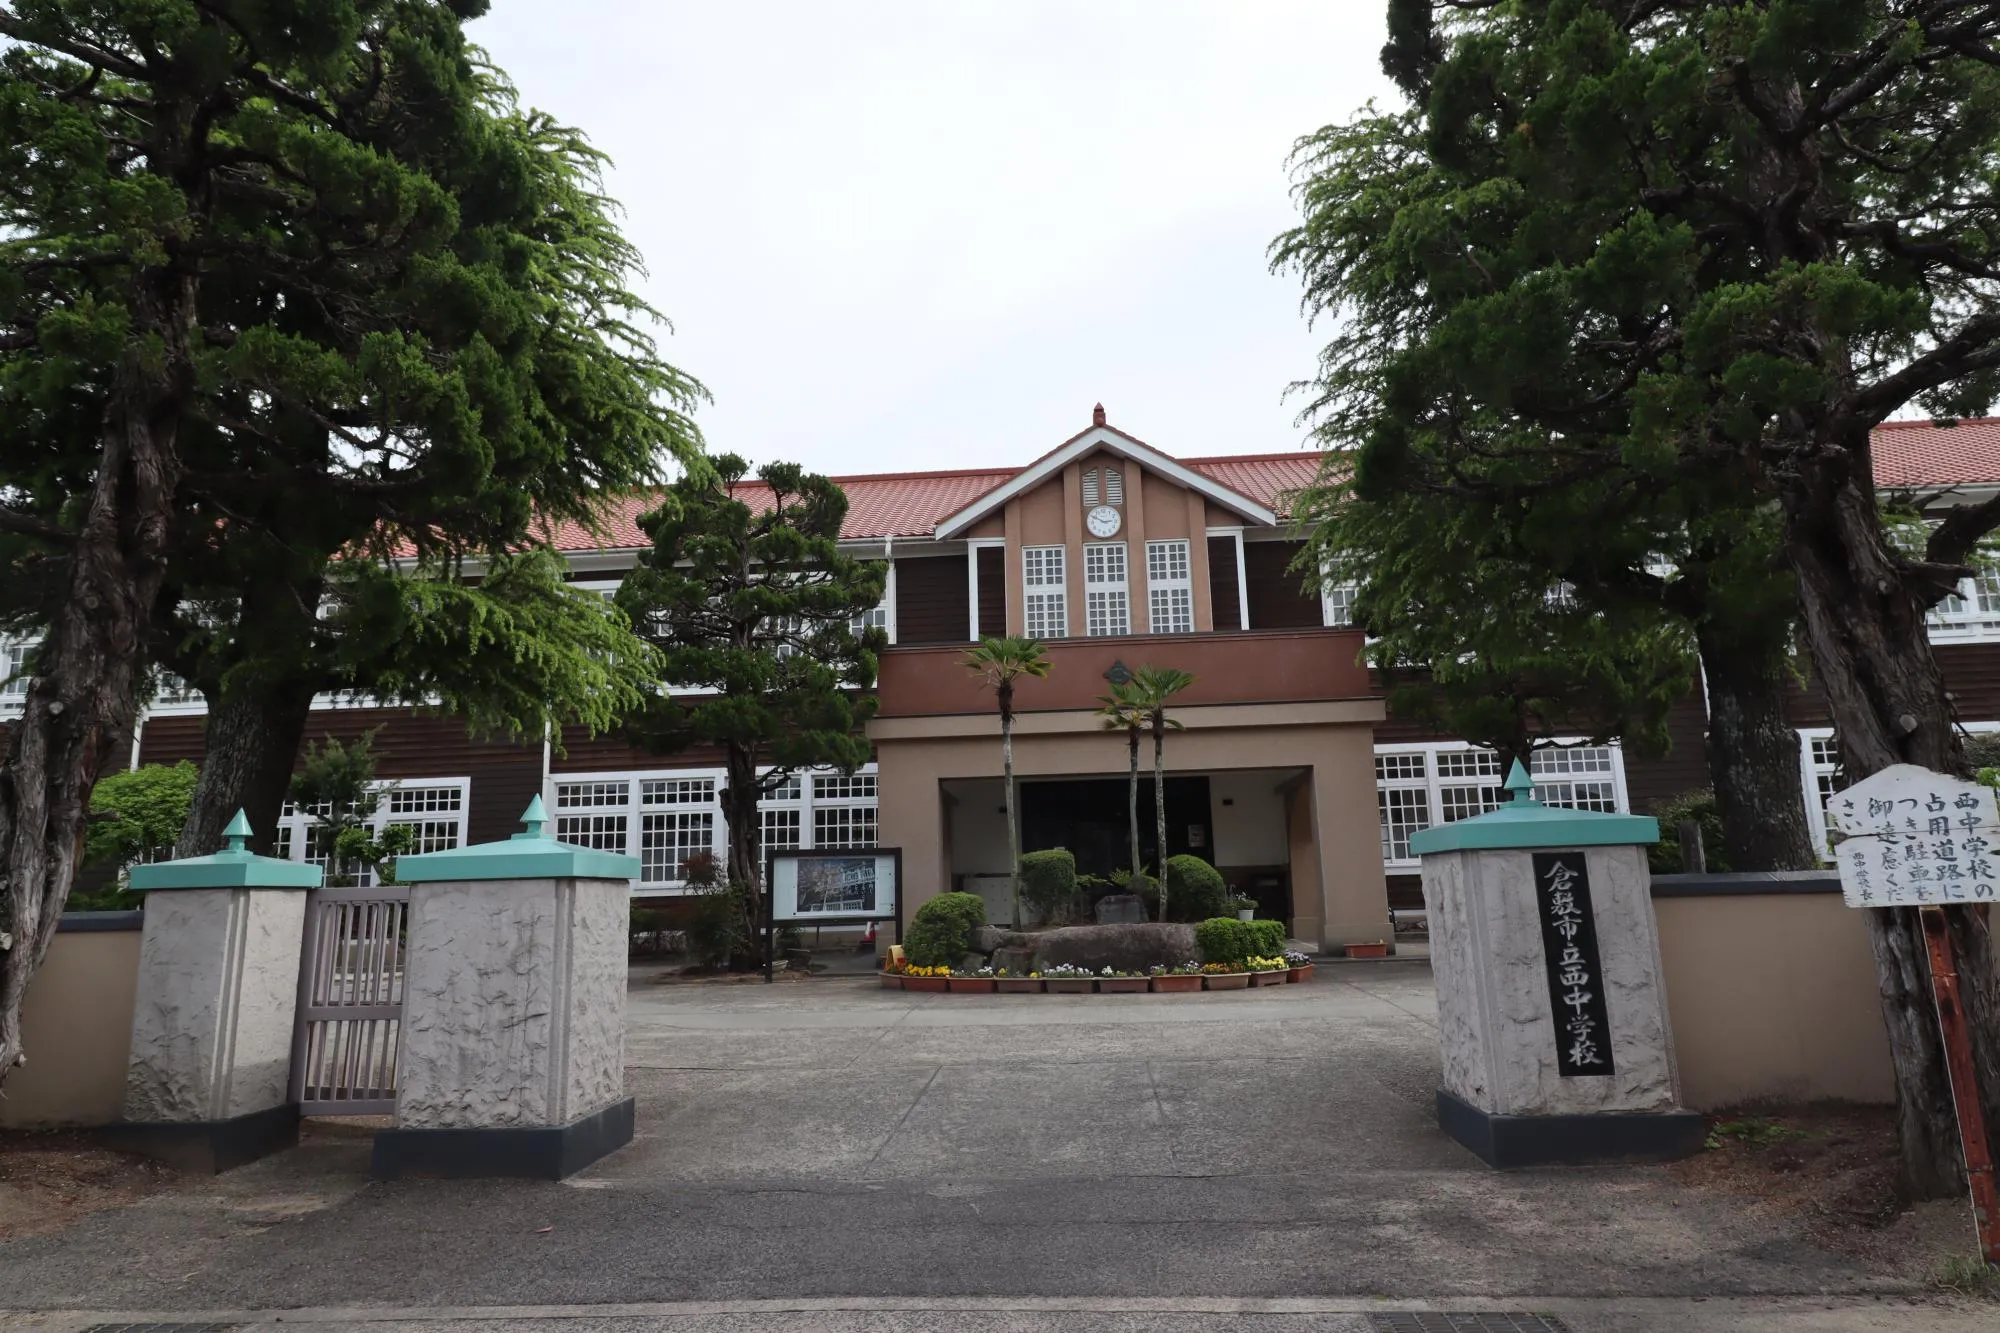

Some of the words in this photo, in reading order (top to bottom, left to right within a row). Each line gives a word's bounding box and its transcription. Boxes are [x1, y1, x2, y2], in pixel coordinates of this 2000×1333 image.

[1842, 799, 1863, 830] さい
[1867, 797, 1904, 902] 御遠慮くだ
[1897, 798, 1934, 900] つき駐車を
[1925, 792, 1965, 900] 占用道路に
[1953, 792, 1996, 898] 西中学校の
[1544, 860, 1604, 1068] 倉敷市立西中学校
